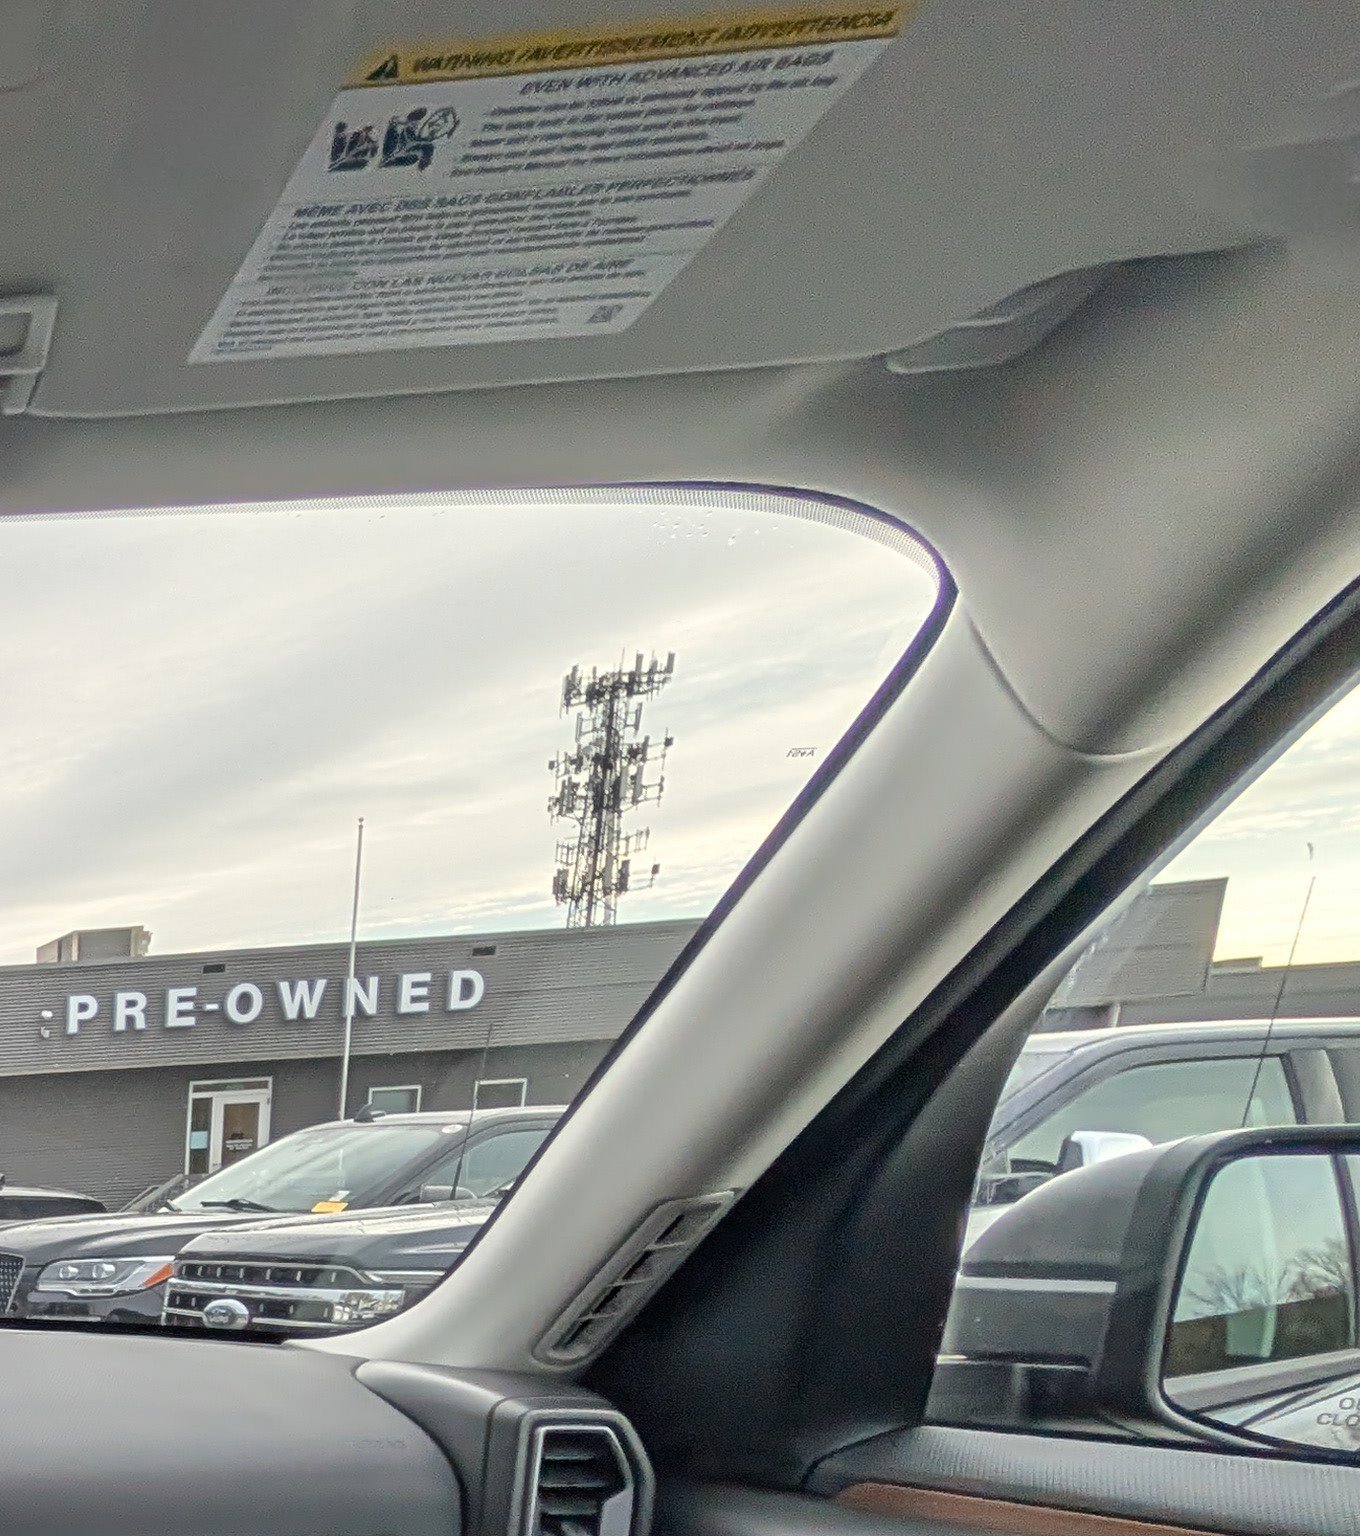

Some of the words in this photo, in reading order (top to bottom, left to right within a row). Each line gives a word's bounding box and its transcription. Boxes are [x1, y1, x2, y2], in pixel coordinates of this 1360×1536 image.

[576, 70, 627, 90] WITH
[628, 60, 733, 84] ADVANCED
[738, 57, 773, 74] AIR
[775, 49, 835, 69] BAGS
[64, 968, 487, 1037] PRE-OWNED
